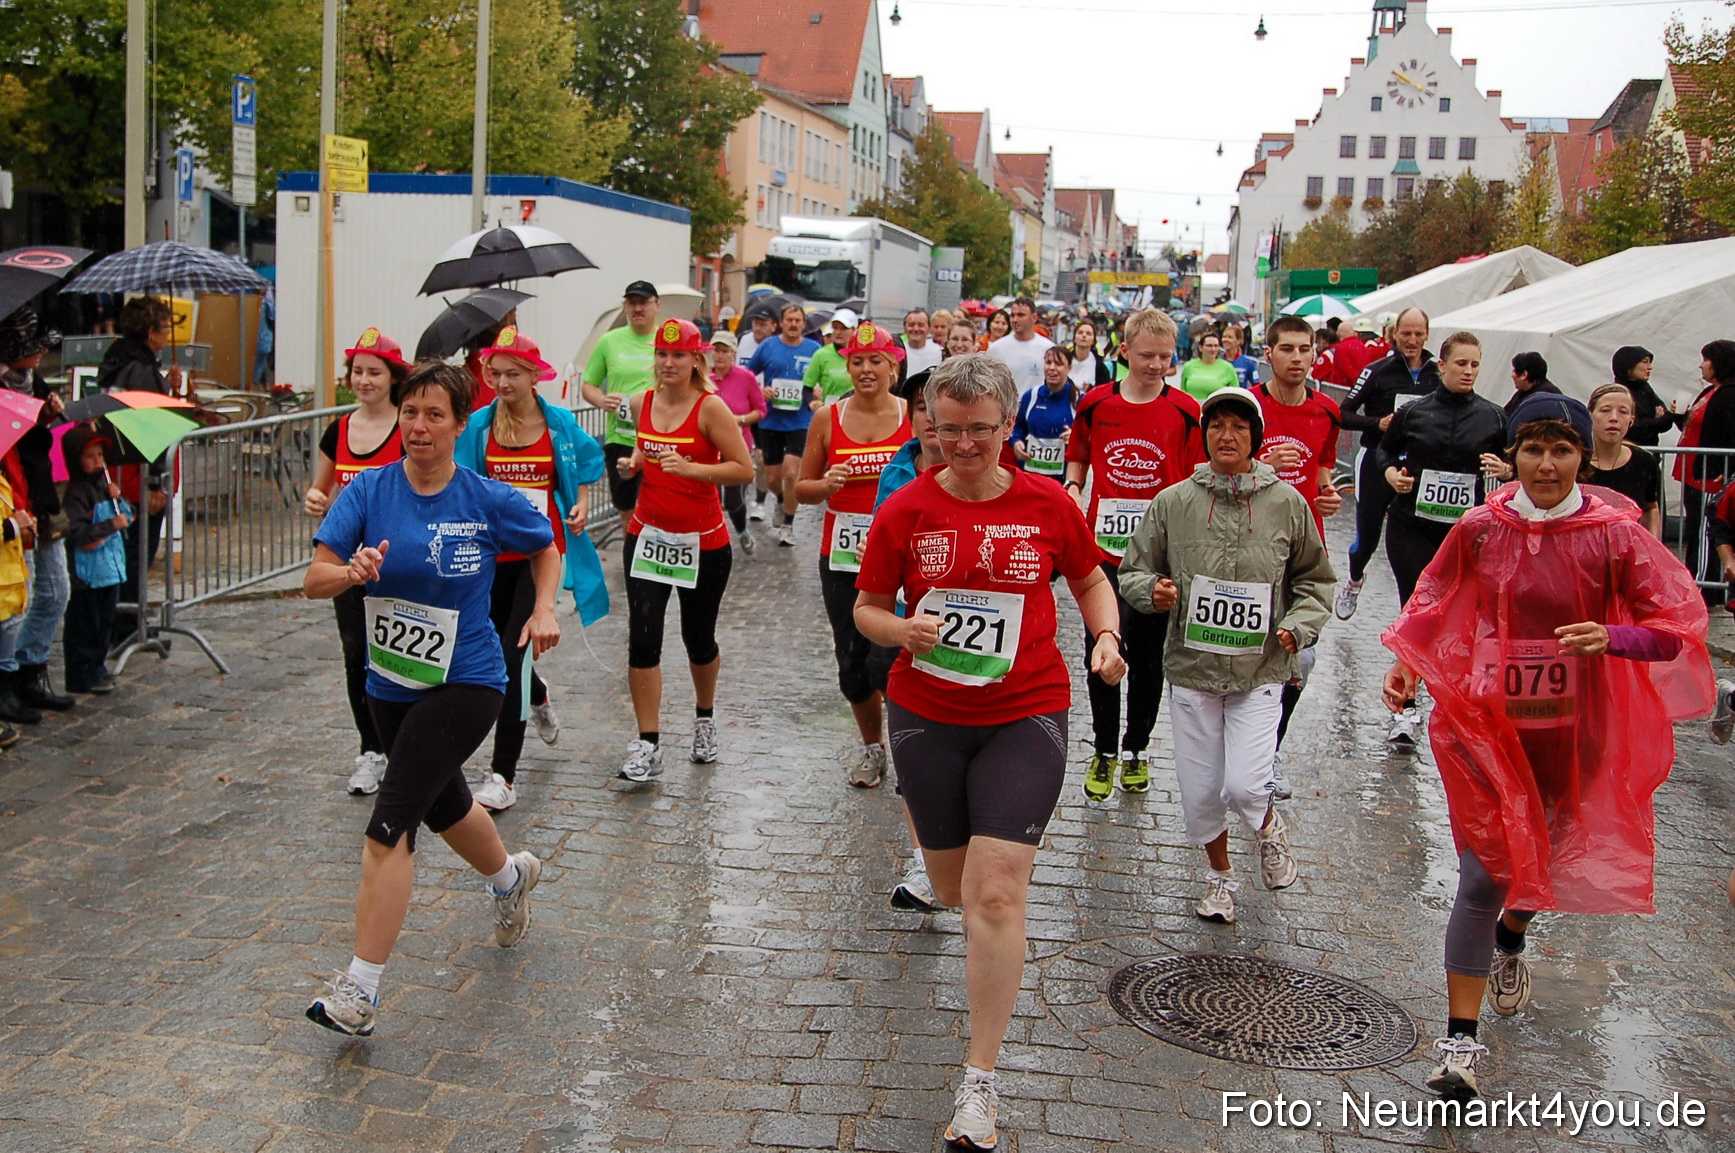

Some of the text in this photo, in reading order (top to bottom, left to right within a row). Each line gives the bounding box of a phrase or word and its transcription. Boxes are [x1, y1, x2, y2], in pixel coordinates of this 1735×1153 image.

[181, 156, 191, 195] P
[1113, 275, 1143, 283] START
[774, 388, 800, 400] 5152
[1030, 445, 1061, 462] 5107
[1103, 438, 1166, 460] METALLVERARBEITUNG
[1107, 447, 1160, 470] Endres
[493, 464, 537, 473] DURST
[1424, 483, 1470, 507] 5005
[439, 522, 488, 531] NEUMARKTER
[973, 523, 1041, 535] 11. NEUMARKTER
[1102, 514, 1143, 535] 500
[838, 528, 870, 550] 51
[985, 530, 1032, 539] STADTLAUF
[917, 537, 950, 548] IMMER
[917, 545, 951, 554] WIEDER
[642, 540, 693, 567] 5035
[920, 553, 948, 565] NEU
[655, 565, 674, 577] Lisa
[921, 564, 948, 573] MARKT
[1195, 595, 1262, 631] 5085
[374, 614, 446, 664] 5222
[1202, 629, 1249, 646] Gertraud
